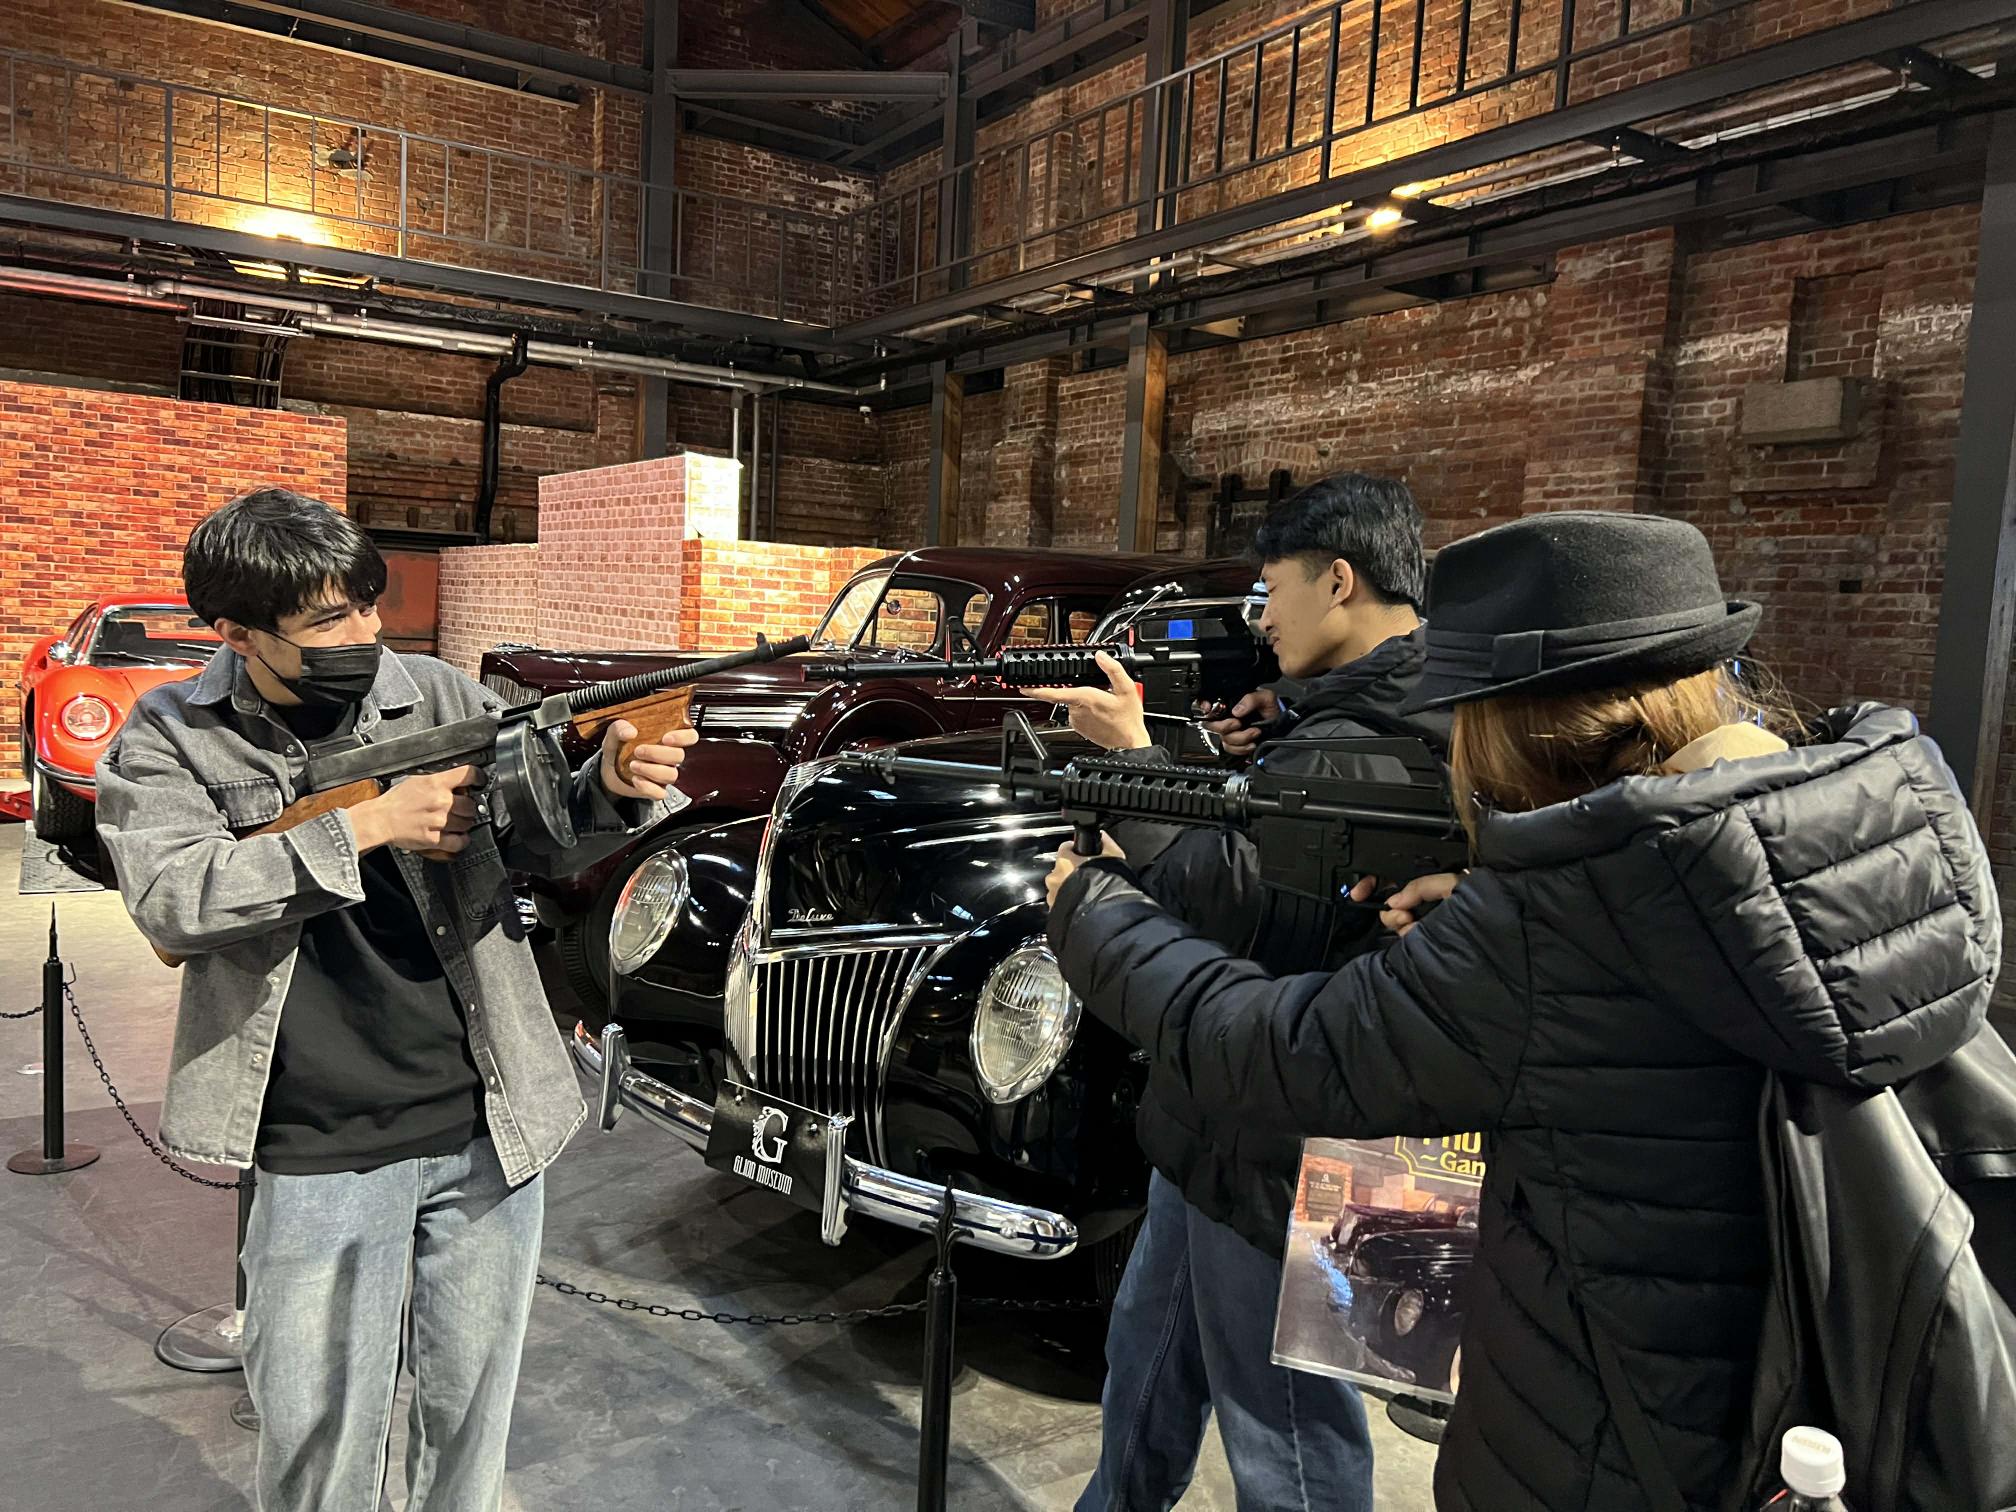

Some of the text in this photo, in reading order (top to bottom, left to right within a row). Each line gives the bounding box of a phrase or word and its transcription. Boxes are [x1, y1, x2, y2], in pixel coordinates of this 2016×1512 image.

[751, 1106, 789, 1164] G
[733, 1154, 793, 1195] GLION MUSEUM
